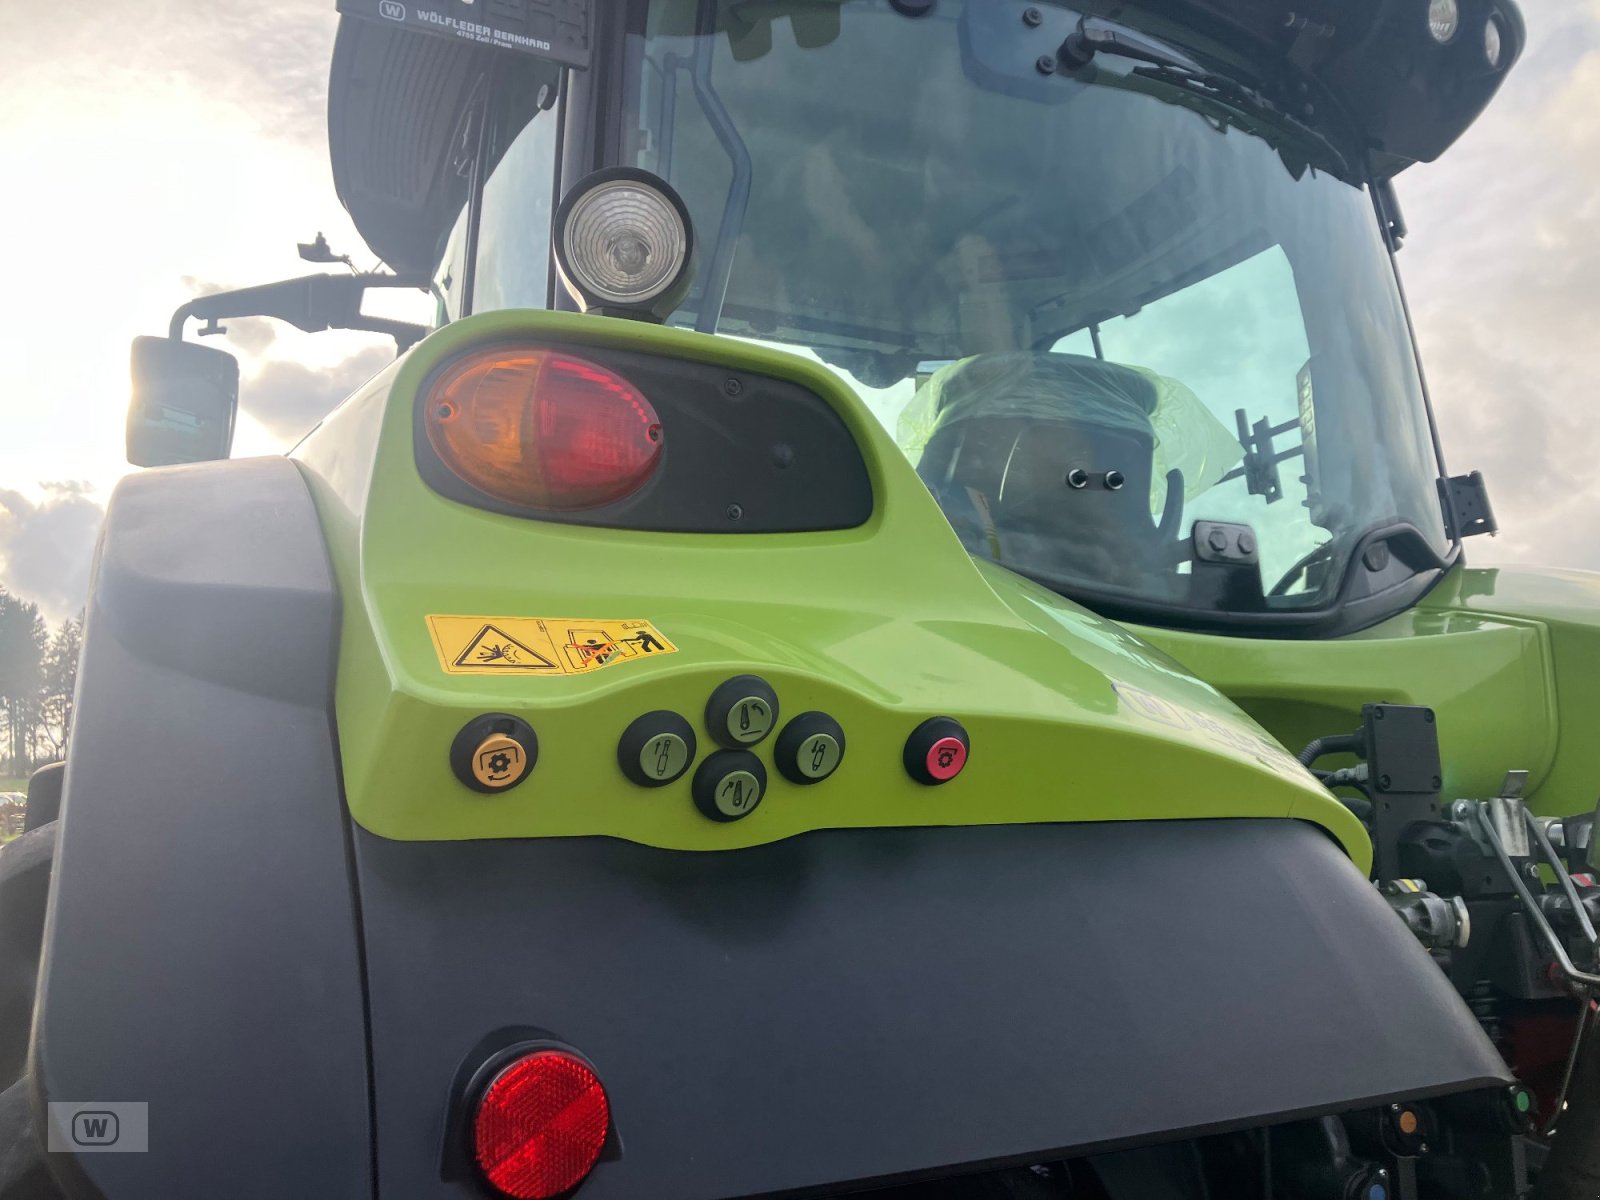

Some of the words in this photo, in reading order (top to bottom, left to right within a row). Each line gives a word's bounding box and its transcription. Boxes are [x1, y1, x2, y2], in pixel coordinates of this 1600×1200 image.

[385, 4, 400, 17] W
[416, 9, 491, 36] WÖLFLEDER
[493, 29, 551, 51] BERNHARD
